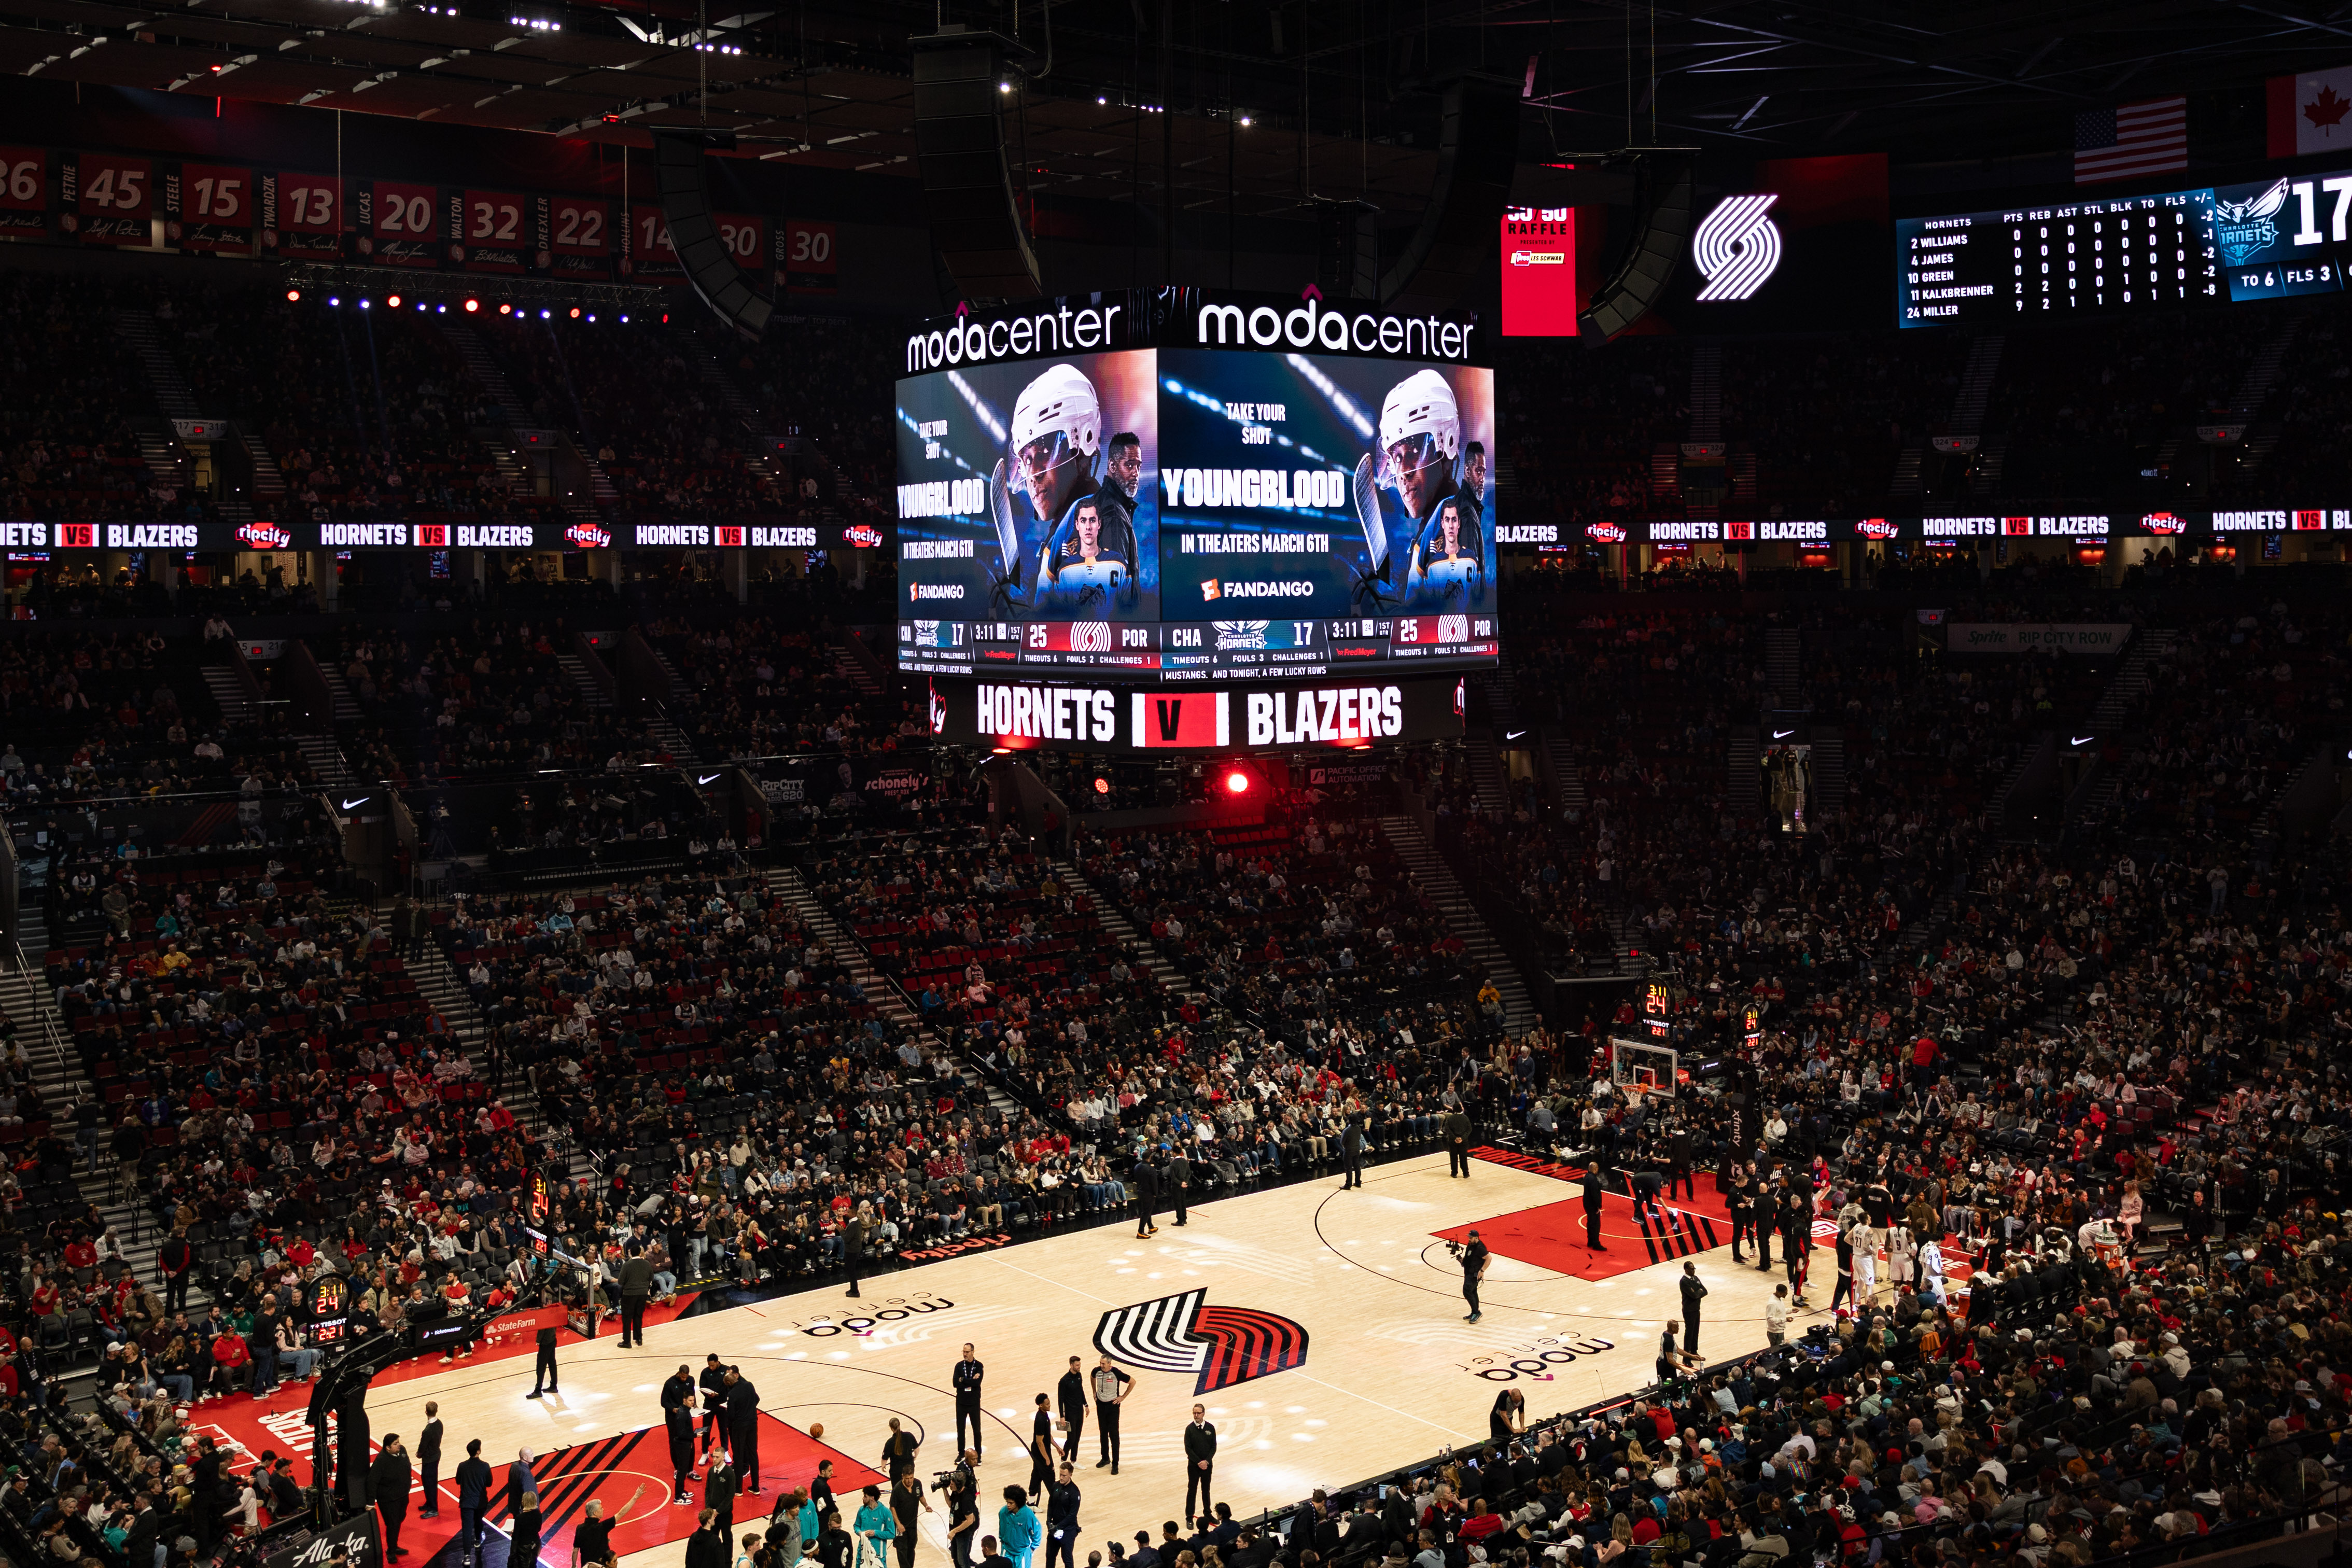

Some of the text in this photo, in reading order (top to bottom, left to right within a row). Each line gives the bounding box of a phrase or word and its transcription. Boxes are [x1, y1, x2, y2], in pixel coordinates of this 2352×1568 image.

[62, 164, 76, 202] PETRIE
[86, 169, 145, 208] 45
[166, 174, 179, 213] STEELE
[193, 178, 241, 217] 15
[262, 175, 275, 228] TWARDZIK
[289, 188, 333, 223] 13
[359, 191, 371, 225] LUCAS
[380, 193, 431, 233] 20
[1925, 218, 1971, 230] HORNETS
[2004, 213, 2023, 223] PTS
[2029, 211, 2051, 220] REB
[2057, 207, 2078, 218] AST
[2084, 205, 2104, 215] STL
[2110, 202, 2132, 212] BLK
[2140, 199, 2155, 209] TO
[2165, 195, 2186, 206] FLS
[451, 196, 463, 240] WALTON
[472, 202, 519, 240] 32
[538, 197, 548, 250] DREXLER
[556, 207, 604, 246] 22
[1508, 223, 1566, 234] RAFFLE
[775, 229, 785, 260] GROSS
[791, 231, 830, 262] 30
[1911, 234, 1968, 249] 2 WILLIAMS
[1911, 253, 1954, 266] 4 JAMES
[1908, 271, 1954, 284] 10 GREEN
[2241, 266, 2330, 287] TO 6 FLS 3
[1910, 285, 1993, 301] 11 KALKBRENNER
[1907, 305, 1958, 318] 24 MILLER
[1226, 403, 1285, 421] TAKE YOUR
[1242, 427, 1271, 444] SHOT
[1161, 468, 1345, 507] YOUNGBLOOD
[1649, 522, 1826, 539] HORNETS VS BLAZERS
[1858, 520, 1898, 538] ripcity
[1923, 516, 2109, 536] HORNETS VS BLAZERS
[2143, 514, 2186, 533] ripcity
[2213, 511, 2286, 530] HORNETS
[2300, 512, 2319, 528] VS
[65, 525, 198, 547] VS BLAZERS
[240, 524, 290, 548] ripcity
[321, 524, 533, 547] HORNETS VS BLAZERS
[568, 525, 610, 547] ripcity
[636, 525, 816, 546] HORNETS VS BLAZERS
[846, 526, 883, 547] ripcity
[1495, 525, 1558, 542] BLAZERS
[1588, 524, 1626, 542] ripcity
[1181, 534, 1328, 553] IN THEATERS MARCH 6TH
[1224, 581, 1313, 597] FANDANGO
[1172, 629, 1201, 647] CHA
[1294, 622, 1313, 646] 17
[1333, 622, 1356, 638] 3:11
[1400, 620, 1418, 642] 25
[1475, 620, 1491, 637] POR
[1968, 631, 2111, 644] Sprite RIP CITY ROW
[269, 642, 286, 650] 216
[1220, 638, 1263, 650] HORNETS
[1460, 645, 1488, 653] CHALLENGES
[1166, 666, 1326, 680] MUSTANGS. AND TONIGHT, A FEW LUCKY ROWS
[977, 685, 1115, 742] HORNETS
[1156, 699, 1180, 741] V
[1248, 686, 1402, 746] BLAZERS
[1328, 774, 1381, 784] AUTOMATION
[782, 791, 803, 800] 620
[1650, 985, 1667, 997] 3:11
[1646, 994, 1665, 1014] 24
[1732, 1109, 1740, 1147] xfinity
[1467, 1145, 1588, 1180] PORTLAND
[899, 1234, 1012, 1261] ripcity
[1855, 1236, 1861, 1248] 27
[1896, 1240, 1901, 1251] 9
[320, 1283, 343, 1298] 3:11
[317, 1296, 338, 1313] 24
[792, 1292, 932, 1328] center
[320, 1318, 347, 1327] TISSOT
[801, 1298, 954, 1337] moda
[319, 1325, 343, 1341] 2:21
[292, 1531, 365, 1567] Alaka
